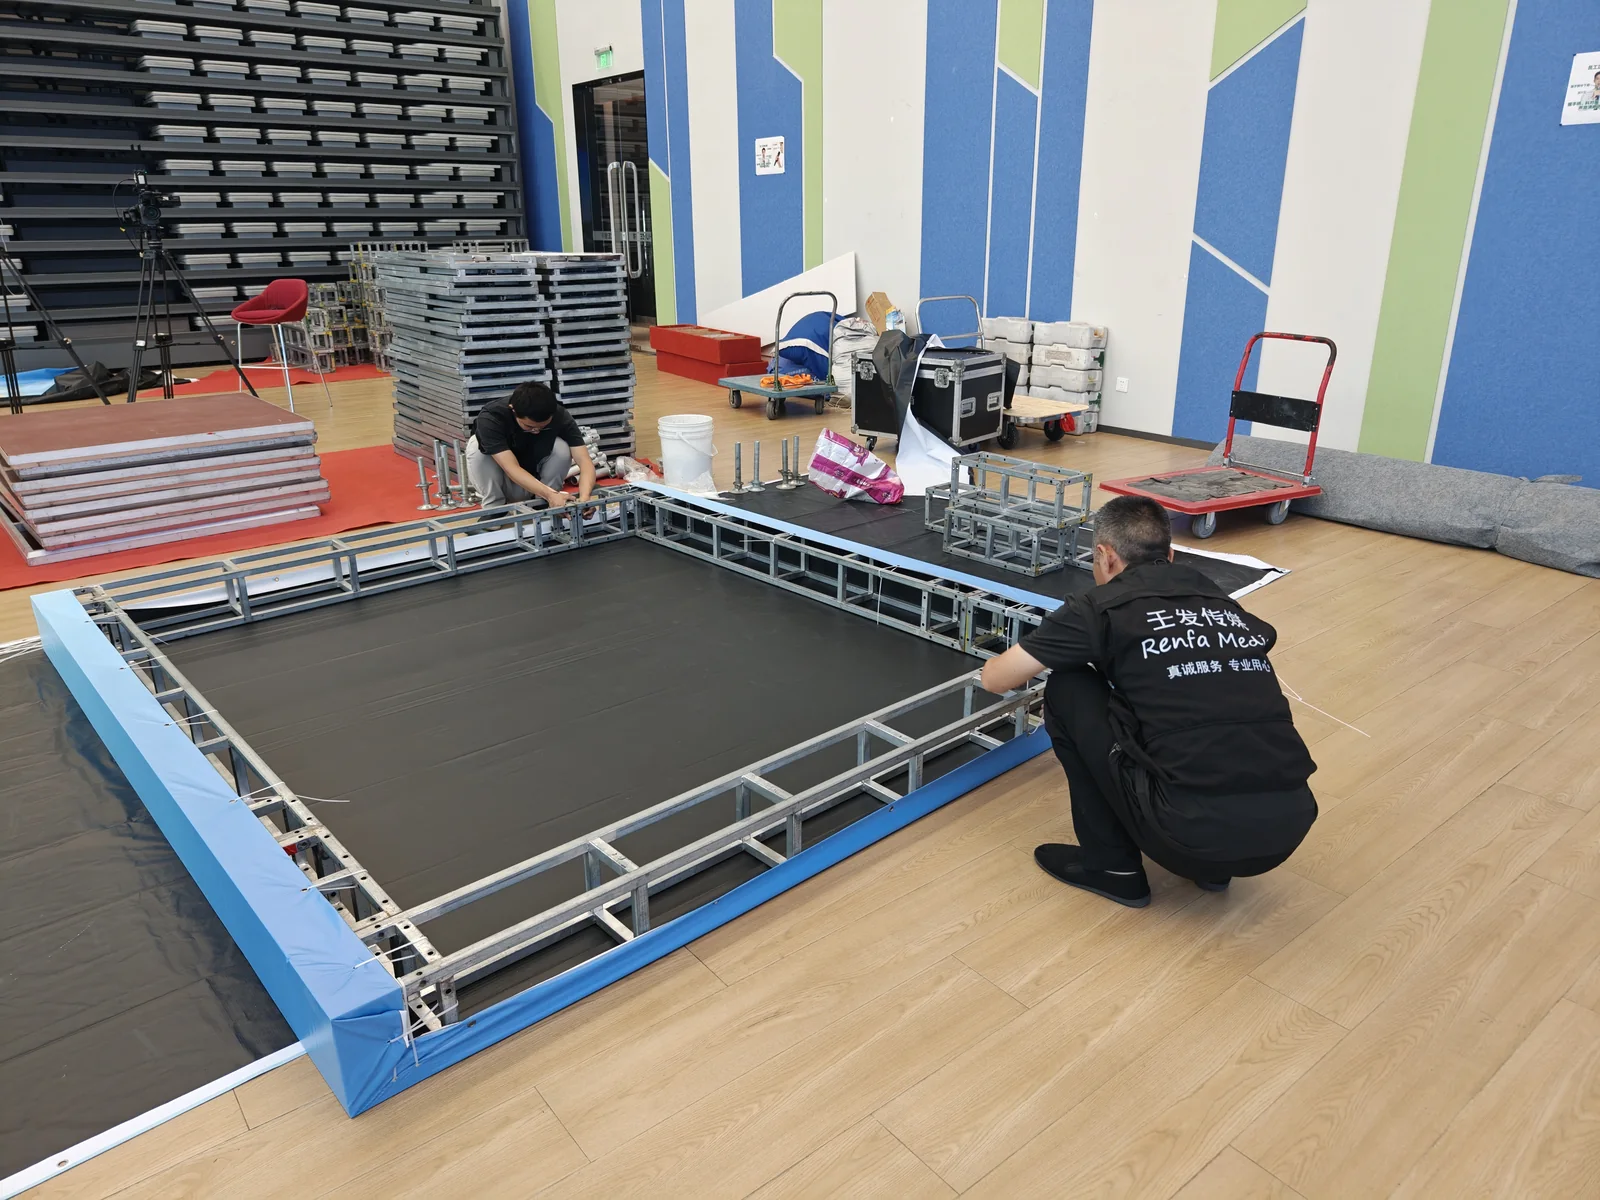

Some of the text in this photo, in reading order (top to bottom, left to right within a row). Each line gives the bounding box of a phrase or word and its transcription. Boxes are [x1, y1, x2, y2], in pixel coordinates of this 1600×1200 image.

[1141, 629, 1268, 660] Renfa Medi
[1166, 658, 1271, 680] 真诚服务 专业用心
